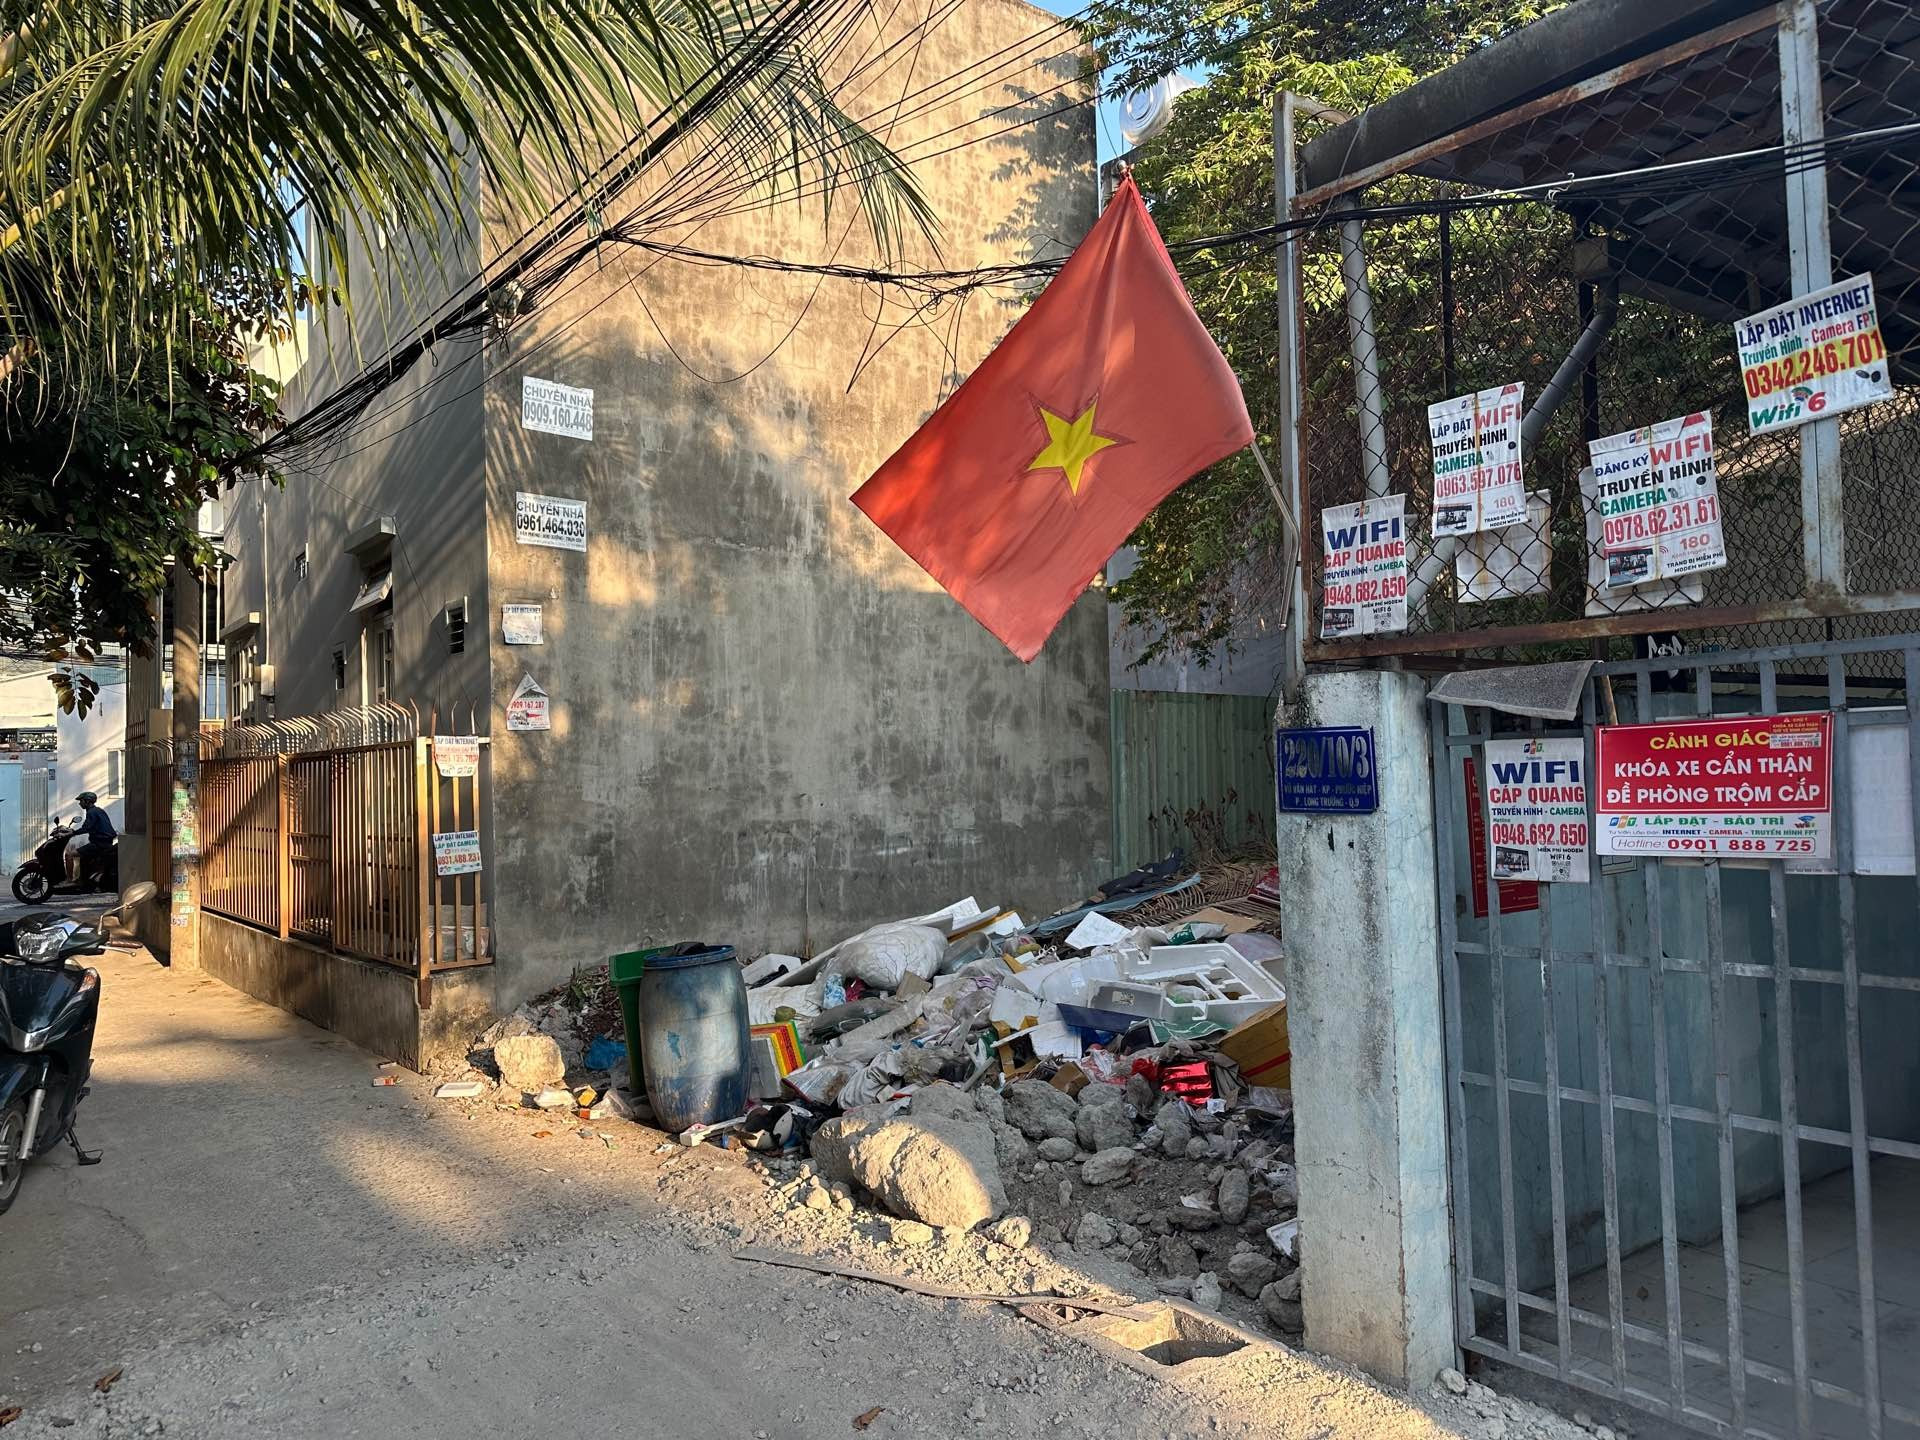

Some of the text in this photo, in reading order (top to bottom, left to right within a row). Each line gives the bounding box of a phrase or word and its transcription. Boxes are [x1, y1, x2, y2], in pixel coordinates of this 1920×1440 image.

[1739, 284, 1871, 348] LẮP ĐẶT INTERNET
[1742, 343, 1778, 367] Truyền
[1811, 319, 1855, 344] Camera
[1856, 309, 1876, 330] FPT
[1744, 329, 1884, 399] 0342.246.701
[1431, 420, 1450, 439] LẮP
[1453, 418, 1472, 436] ĐẶT
[1474, 402, 1521, 430] WIFI
[1751, 391, 1827, 428] Wifi 6
[1479, 428, 1508, 447] HÌNH
[1434, 451, 1485, 475] CAMERA
[1594, 432, 1713, 477] ĐĂNG KÝ WIFI
[1597, 456, 1713, 498] TRUYỀN HÌNH
[1600, 487, 1667, 517] CAMERA
[1326, 517, 1401, 551] WIFI
[1603, 496, 1718, 546] 0978.62.31.61
[1324, 540, 1405, 569] CÁP QUANG
[1679, 533, 1711, 550] 180
[1373, 560, 1405, 573] CAMERA
[1323, 575, 1407, 608] 0948.682.650
[1649, 731, 1708, 750] CẢNH
[1714, 729, 1770, 748] GIÁC
[1284, 735, 1369, 779] 220/10/3
[1614, 750, 1813, 778] KHÓA XE CẨN THẬN
[1491, 760, 1580, 785] WIFI
[1489, 785, 1585, 804] CÁP QUANG
[1606, 777, 1821, 807] ĐỀ PHÒNG TRỘM CẮP
[1523, 806, 1543, 816] HÌNH
[1549, 807, 1585, 816] CAMERA
[1608, 815, 1638, 829] FPT
[1644, 814, 1674, 826] LẮP
[1678, 815, 1708, 827] ĐẶT
[1723, 814, 1756, 826] BẢO
[1759, 815, 1785, 825] TRÌ
[1492, 823, 1587, 846] 0948.682.650
[1617, 838, 1812, 852] Hotline: 0901 888 725
